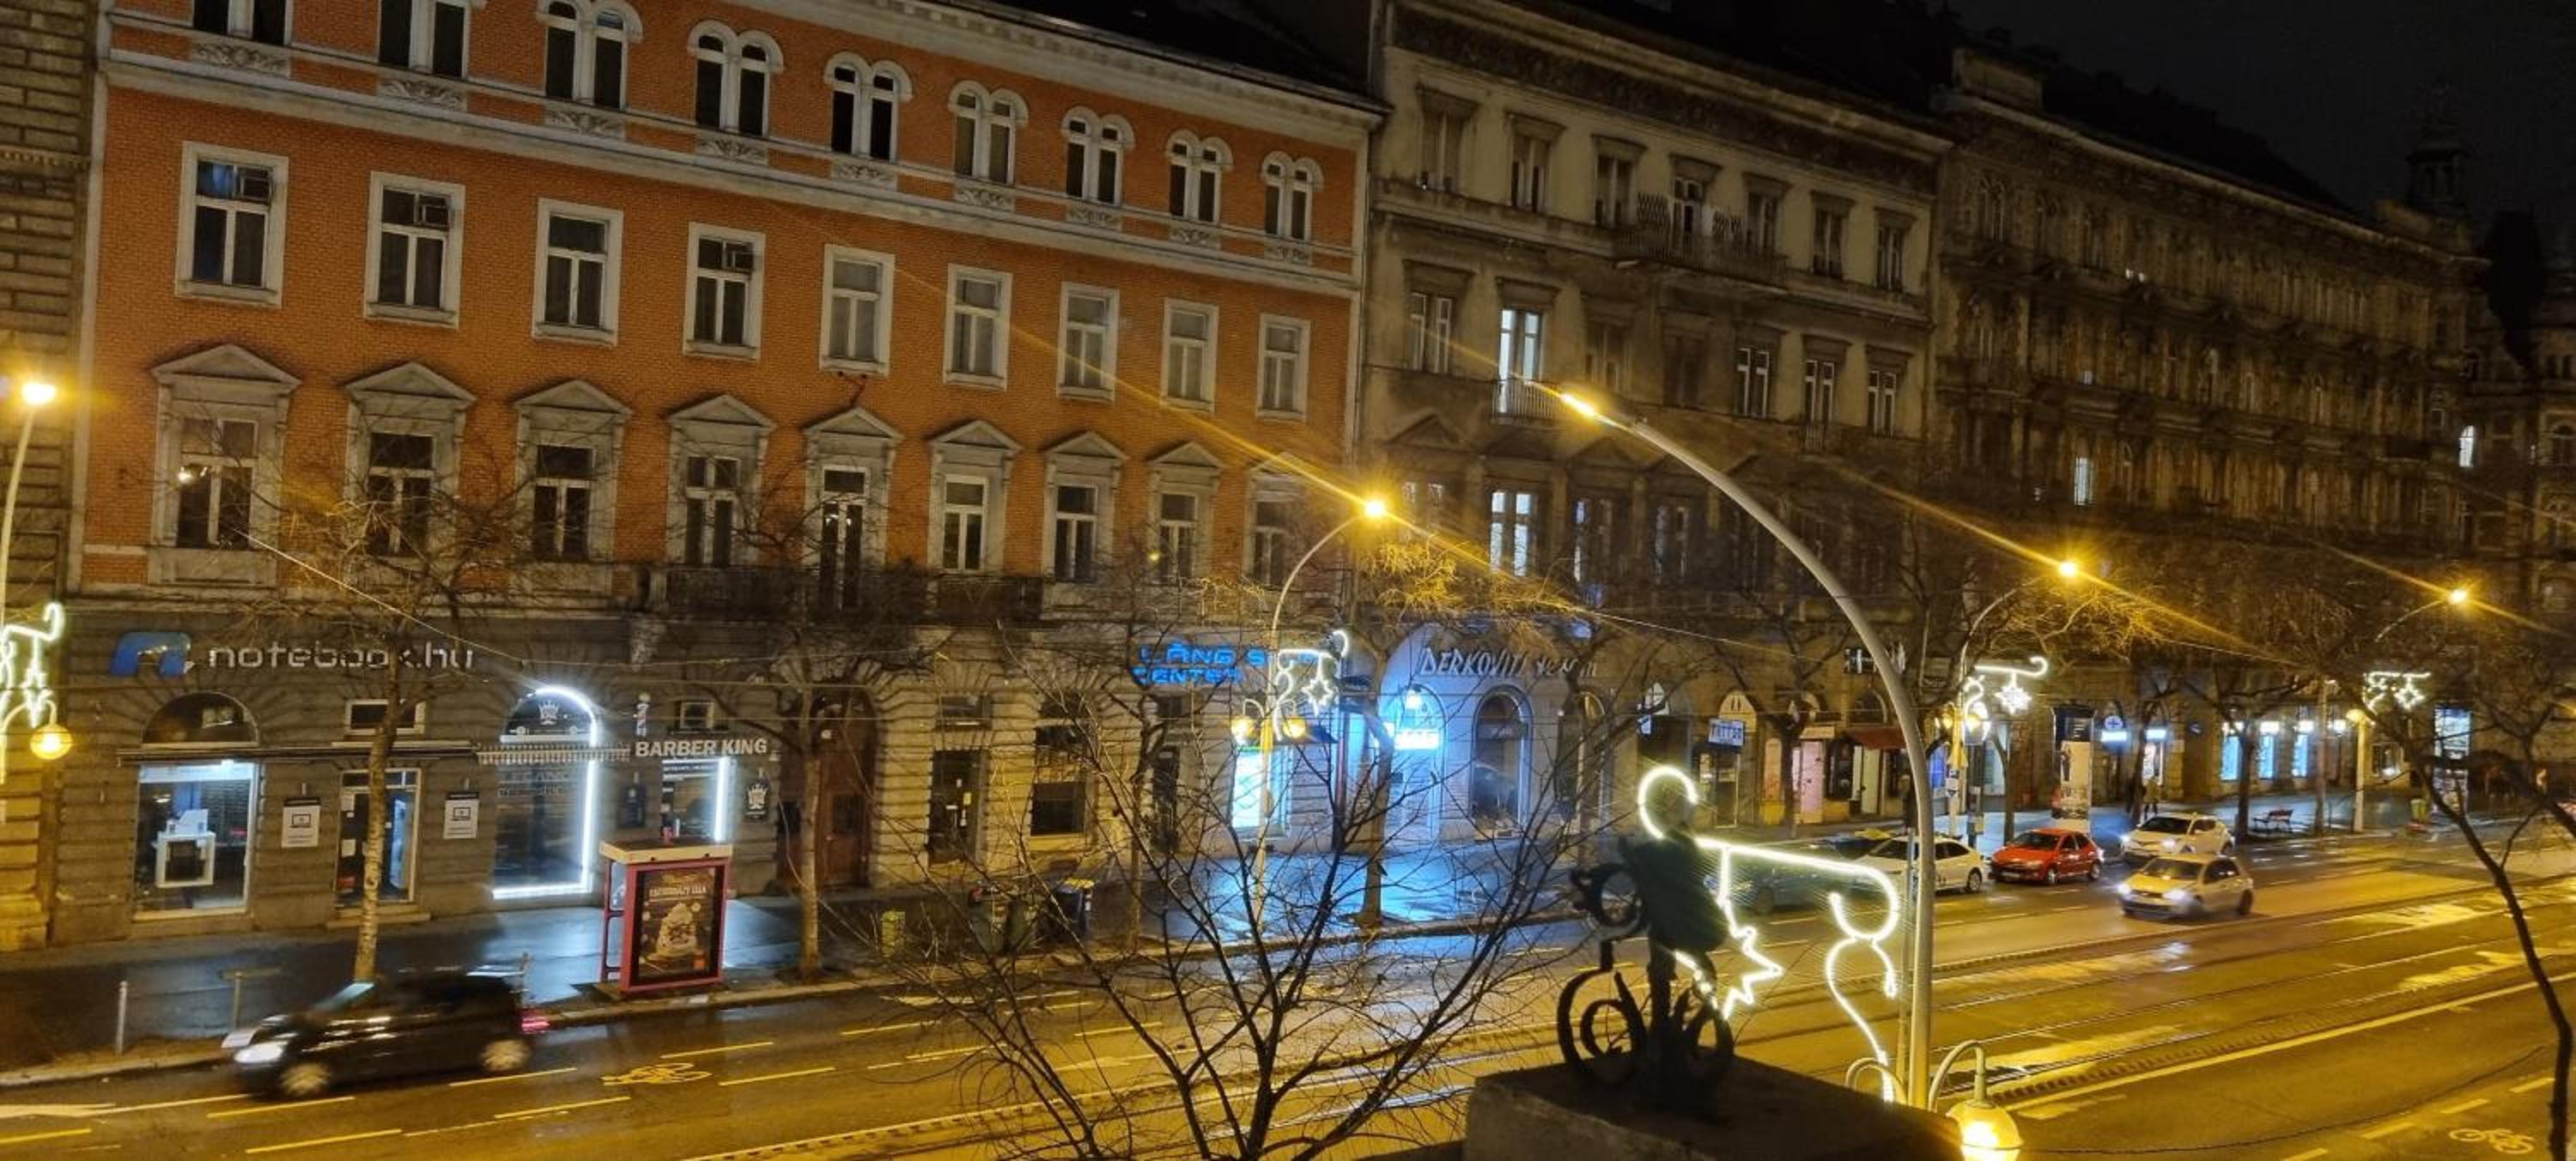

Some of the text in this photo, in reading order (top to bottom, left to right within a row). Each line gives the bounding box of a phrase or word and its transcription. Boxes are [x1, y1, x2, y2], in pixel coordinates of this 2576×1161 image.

[209, 641, 473, 669] notebook.hu
[635, 738, 768, 757] BARBER KING
